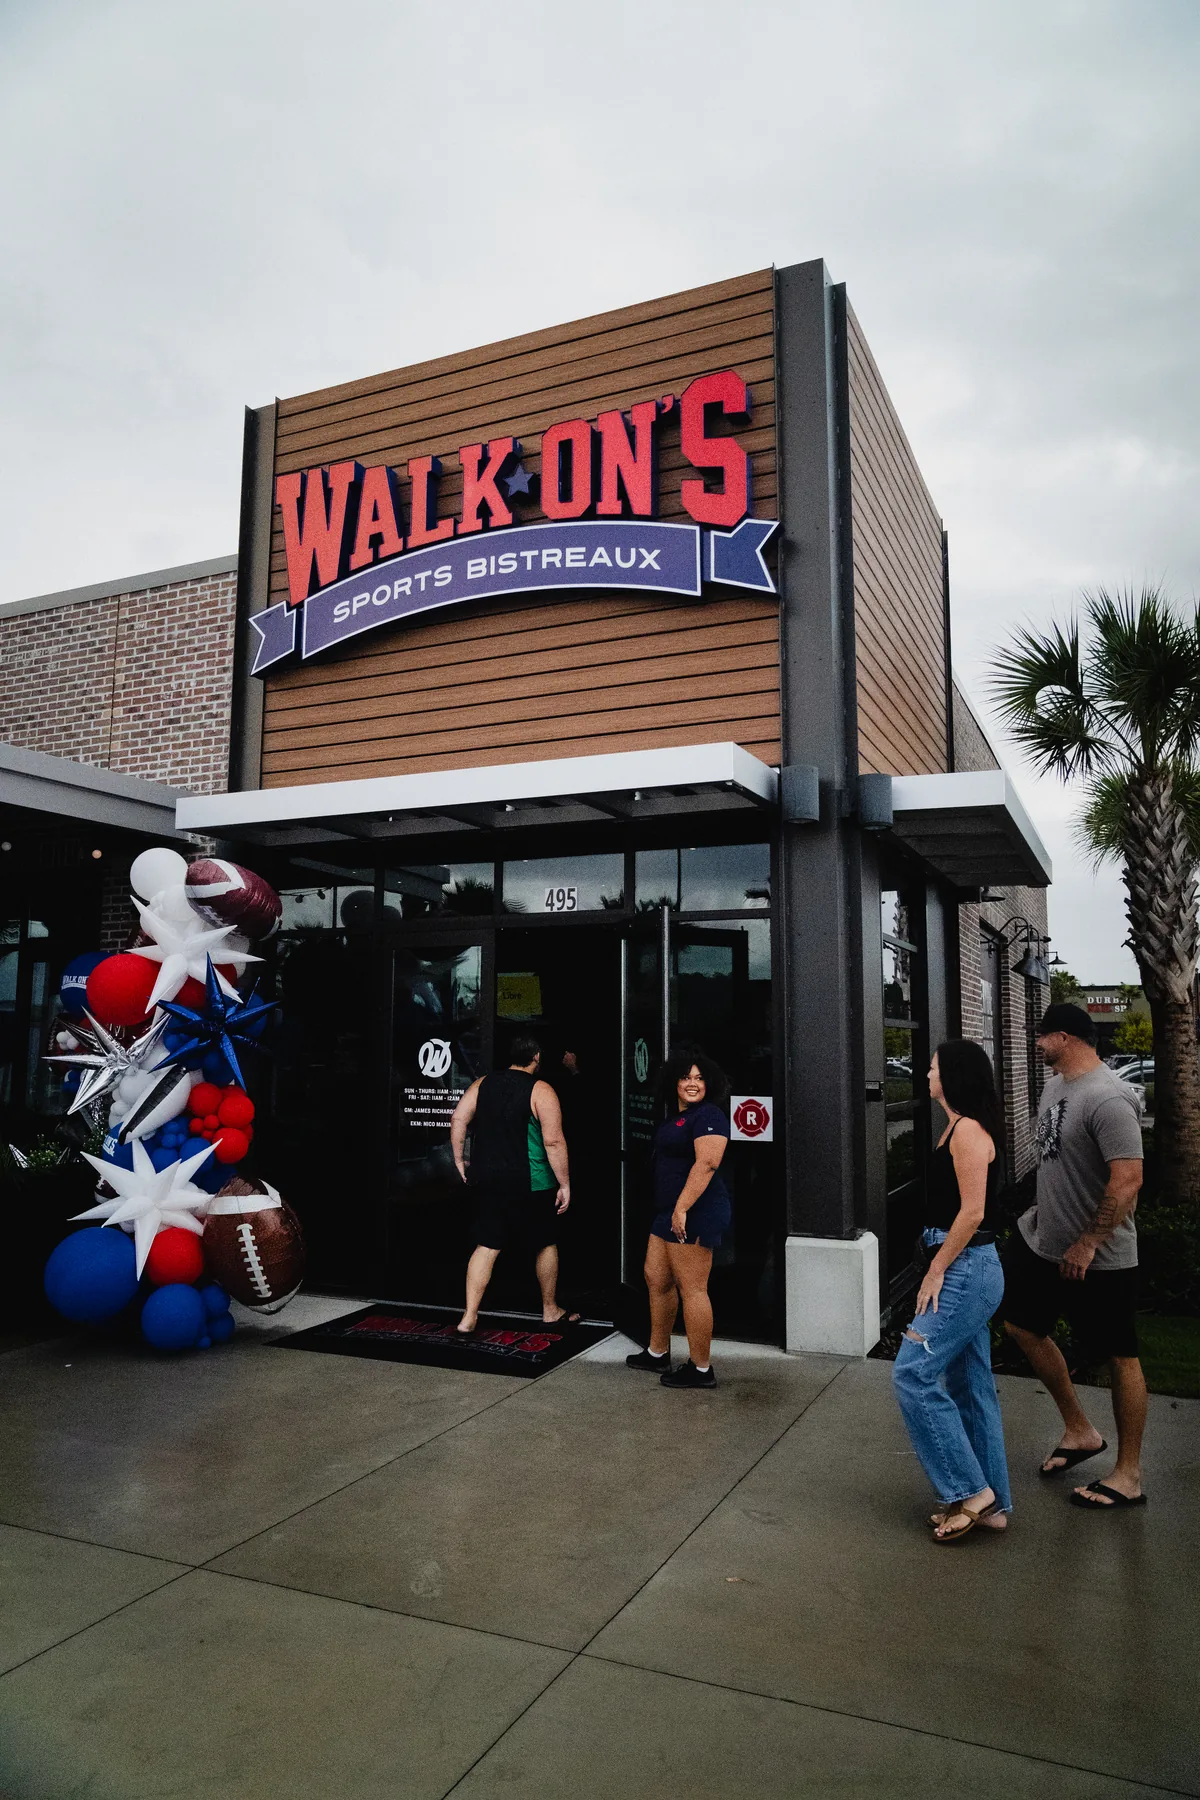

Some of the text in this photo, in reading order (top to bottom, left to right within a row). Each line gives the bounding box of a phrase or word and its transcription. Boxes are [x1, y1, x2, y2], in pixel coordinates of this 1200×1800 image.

[275, 436, 521, 607] WALK
[332, 547, 662, 623] SPORTS BISTREAUX
[545, 887, 577, 912] 495
[746, 1111, 757, 1126] R
